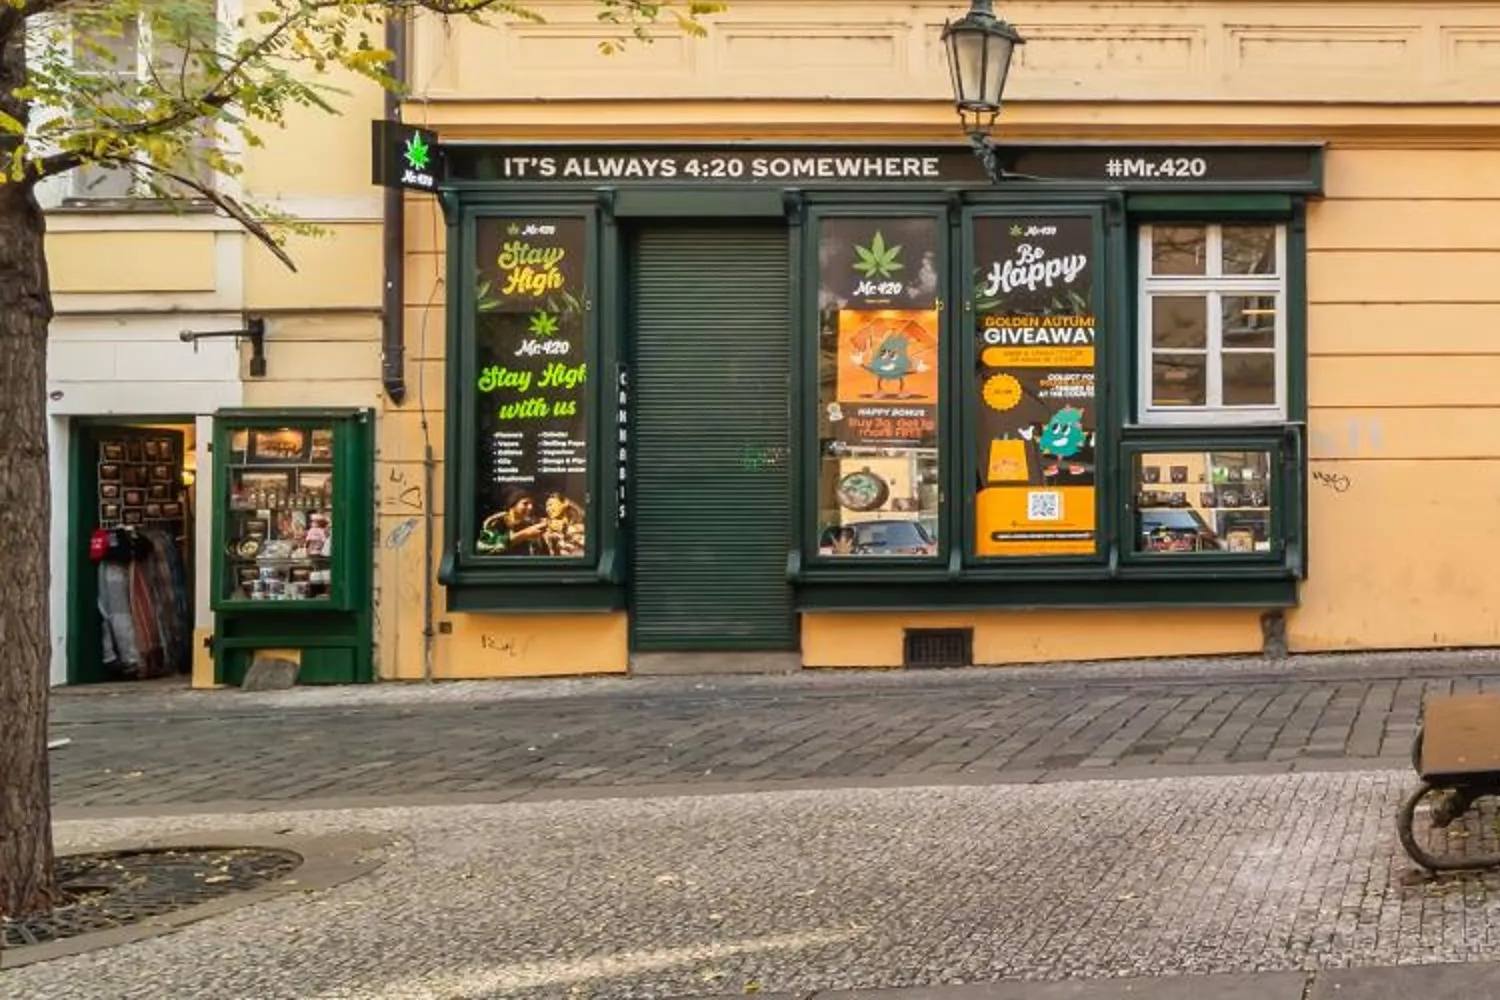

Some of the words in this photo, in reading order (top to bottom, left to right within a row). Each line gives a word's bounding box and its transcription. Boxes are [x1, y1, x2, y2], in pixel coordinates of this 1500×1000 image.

[563, 157, 677, 177] ALWAYS
[684, 158, 744, 177] 4:20
[751, 157, 940, 177] SOMEWHERE
[1106, 158, 1207, 177] #Mr.420
[498, 240, 565, 270] Stay
[1016, 243, 1045, 266] Be
[502, 265, 565, 296] High
[983, 254, 1087, 297] Happy
[985, 316, 1039, 327] GOLDEN
[478, 365, 533, 392] Stay
[499, 397, 549, 419] with
[553, 400, 577, 416] us
